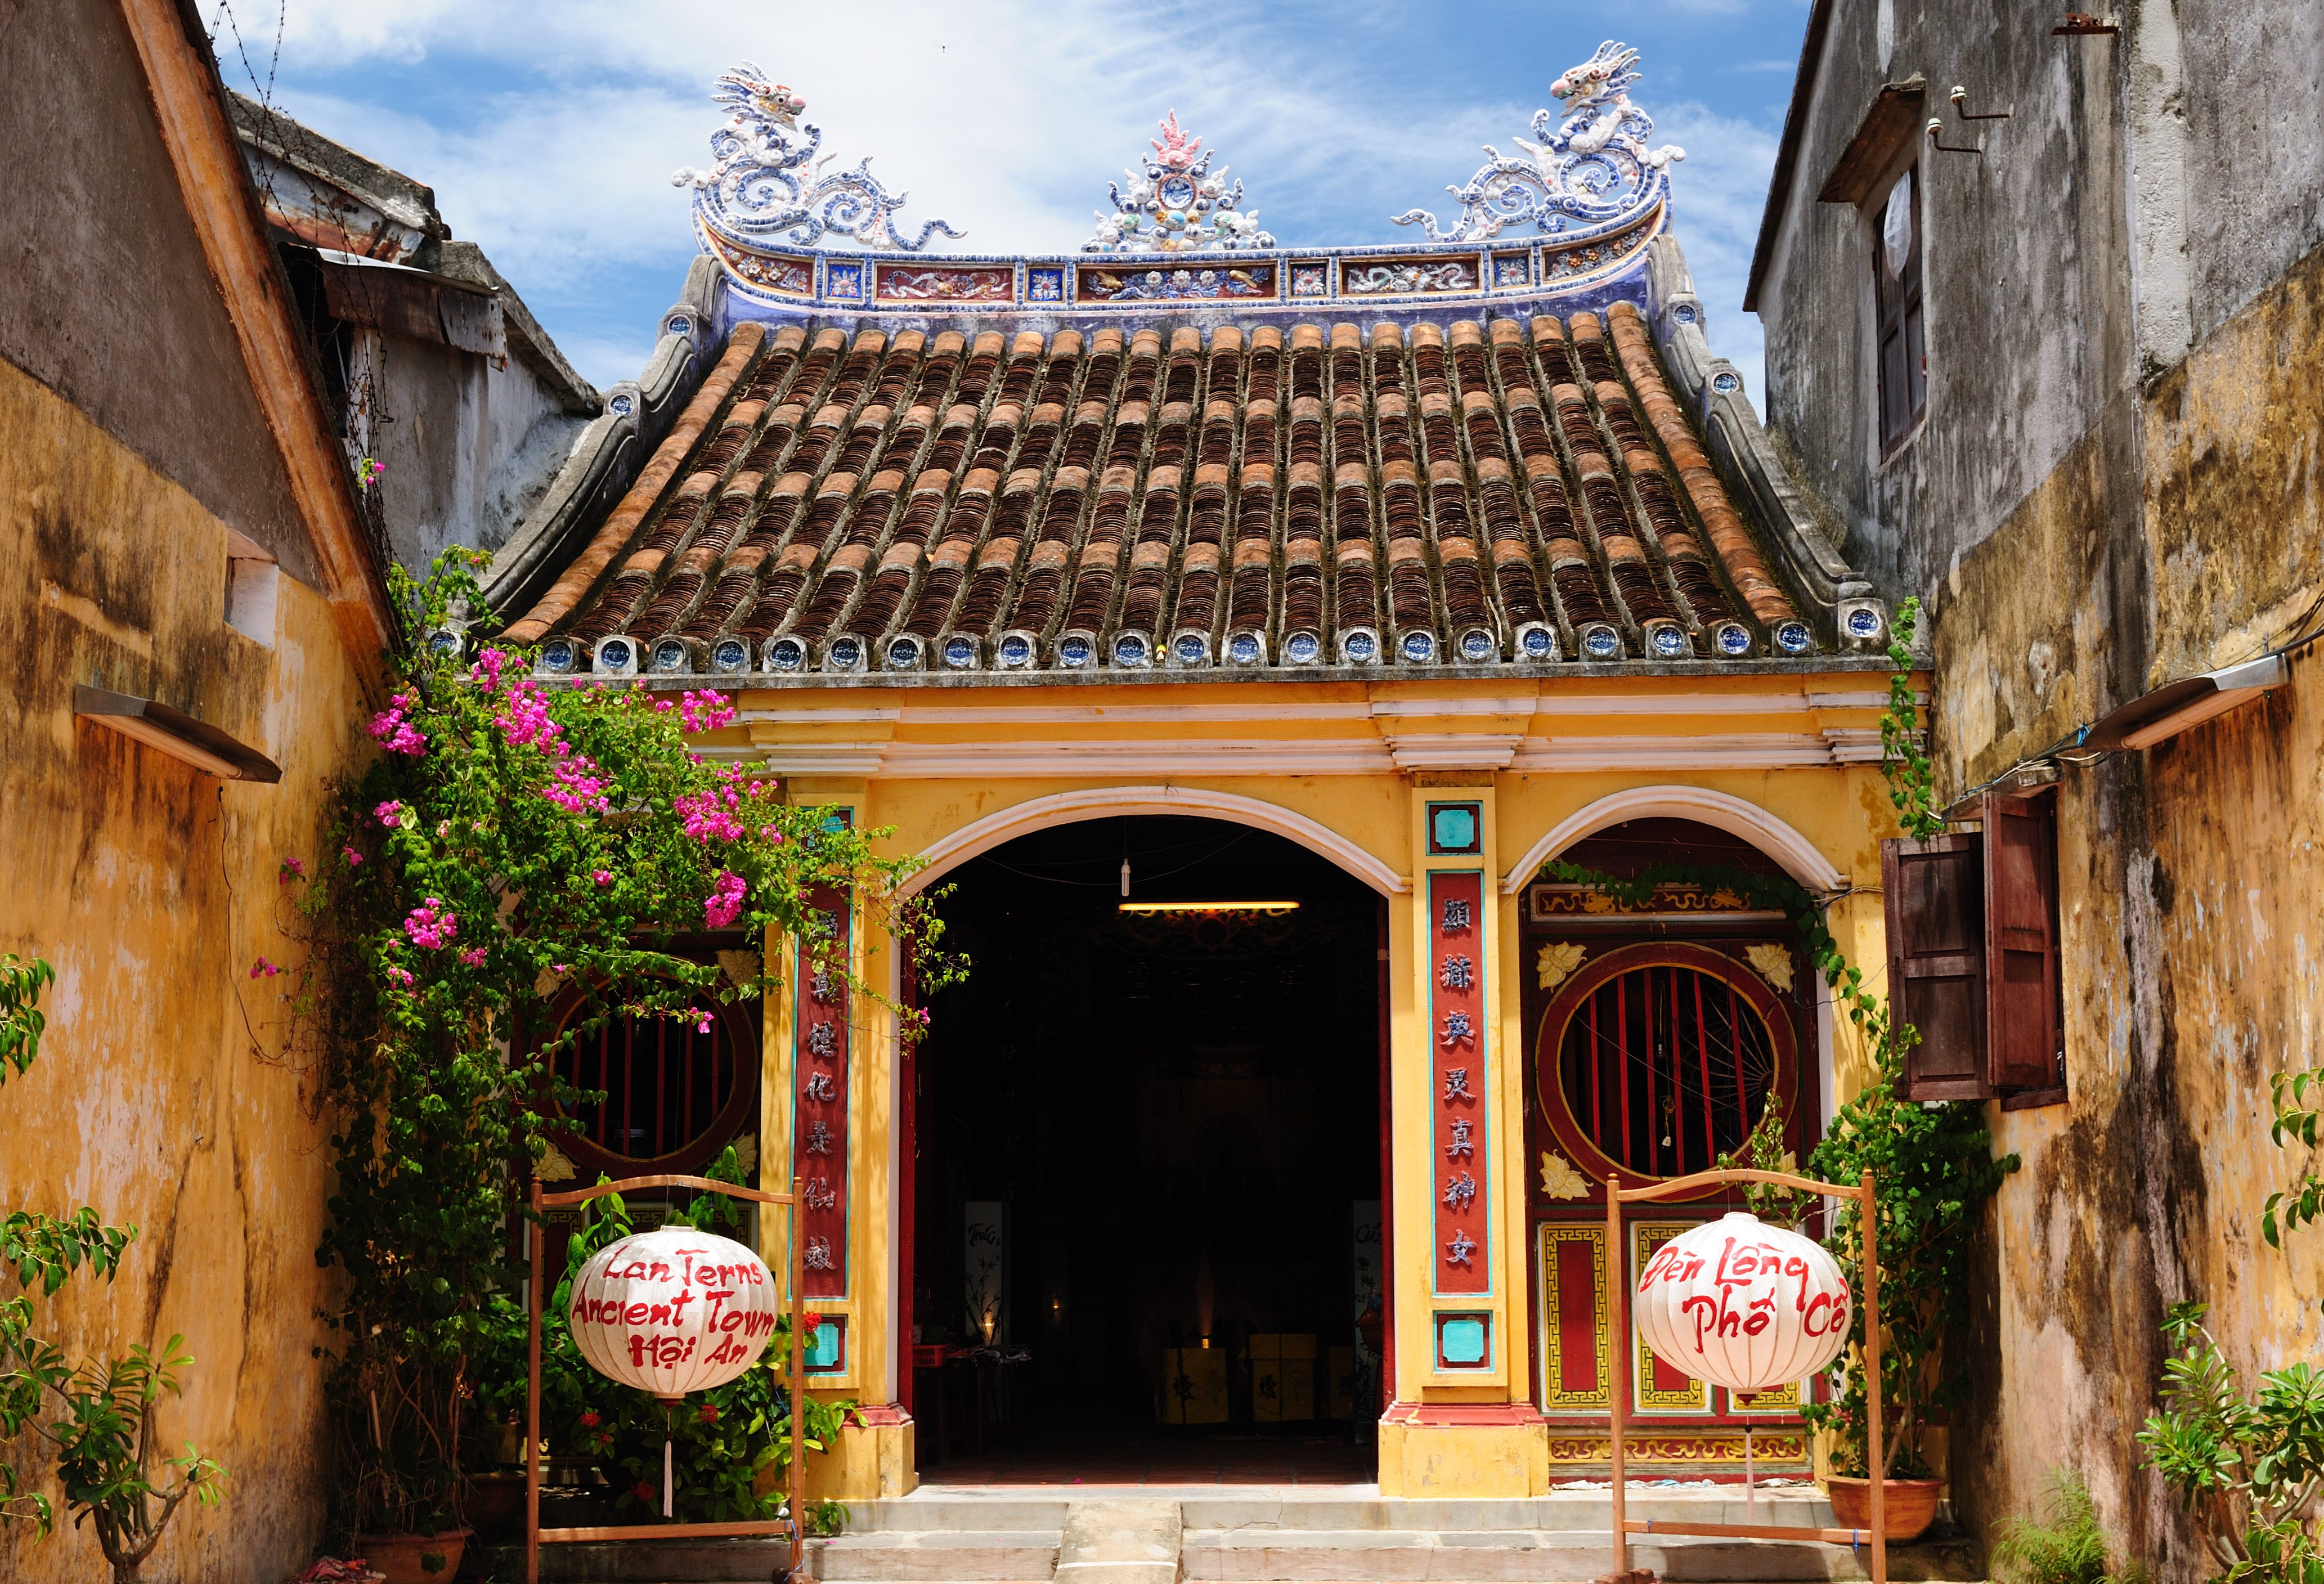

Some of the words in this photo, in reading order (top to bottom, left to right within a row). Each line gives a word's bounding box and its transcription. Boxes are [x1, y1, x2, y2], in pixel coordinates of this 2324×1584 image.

[1640, 1246, 1706, 1293] Đèn
[572, 1274, 696, 1327] Ancient
[706, 1291, 774, 1338] Town
[1682, 1284, 1776, 1354] Phố
[1803, 1278, 1849, 1337] Cổ
[627, 1334, 696, 1369] Hội
[705, 1333, 748, 1365] An
